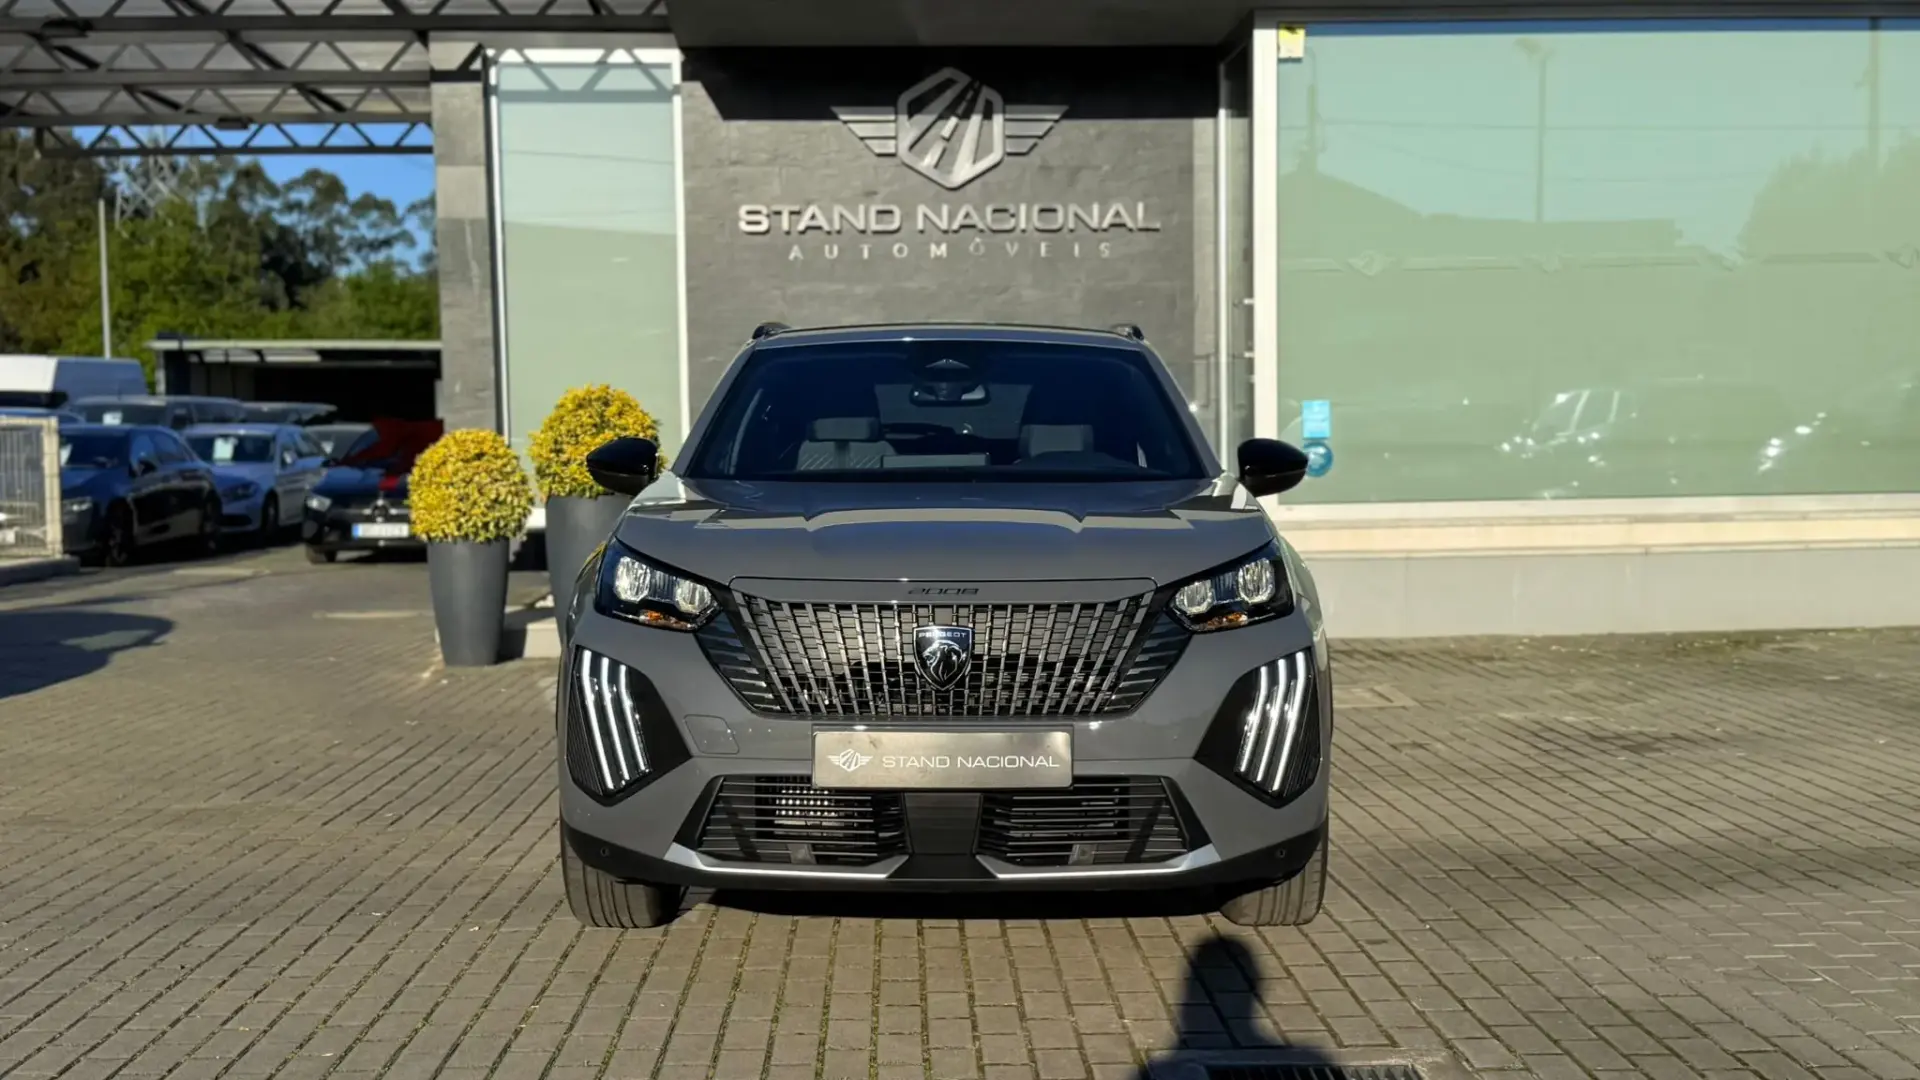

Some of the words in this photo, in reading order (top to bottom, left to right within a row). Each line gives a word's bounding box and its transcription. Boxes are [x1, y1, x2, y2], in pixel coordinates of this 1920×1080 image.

[738, 203, 902, 233] STAND
[916, 202, 1162, 232] NACIONAL
[788, 238, 1111, 261] AUTOMÓVEIS
[907, 587, 979, 595] 2008
[882, 755, 950, 768] STAND
[957, 755, 1060, 768] NACIONAL
